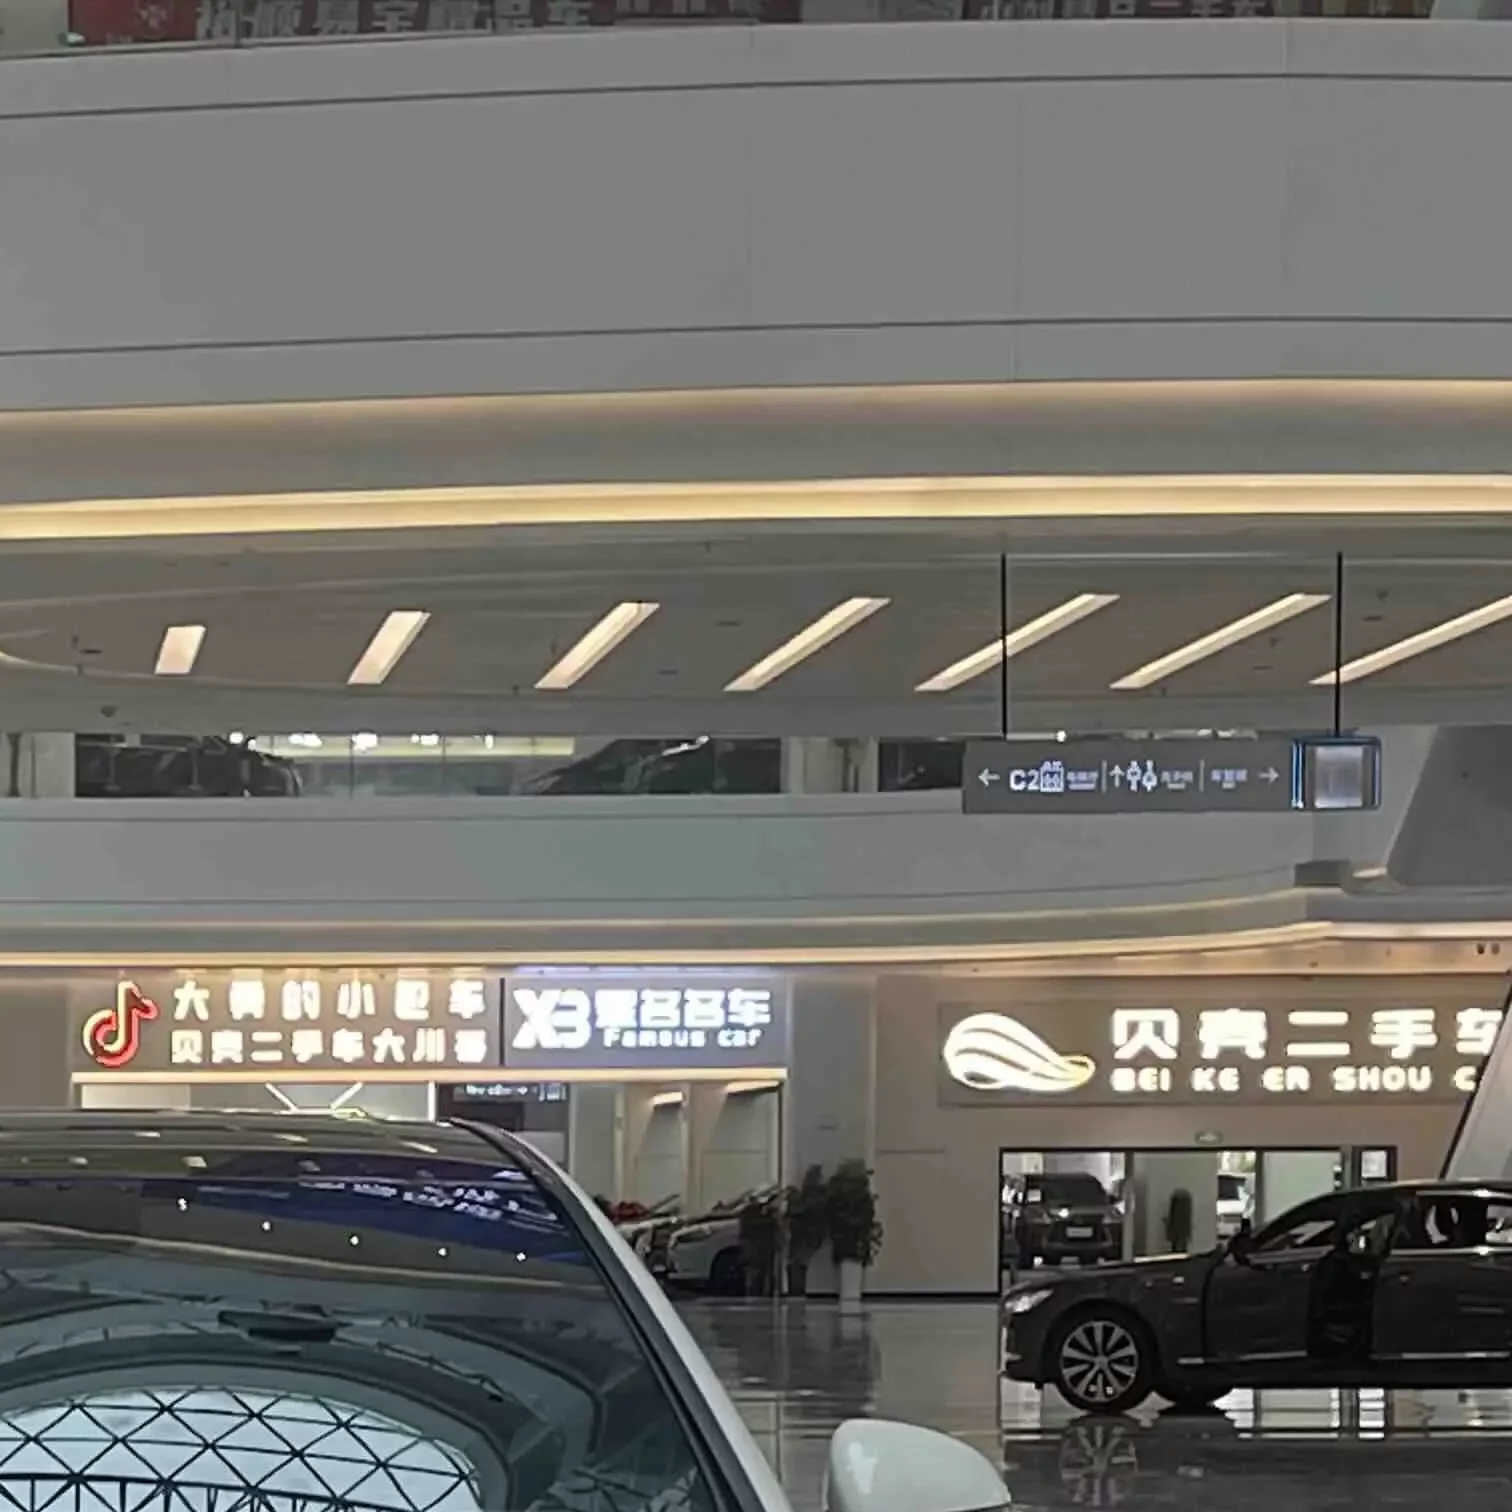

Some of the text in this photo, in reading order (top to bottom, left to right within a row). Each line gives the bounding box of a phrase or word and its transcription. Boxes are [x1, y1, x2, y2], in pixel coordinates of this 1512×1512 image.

[1111, 1008, 1504, 1060] 贝壳二手车
[1110, 1066, 1171, 1092] BEI
[1191, 1066, 1240, 1092] KE
[1260, 1066, 1311, 1092] ER
[1331, 1066, 1432, 1092] SHOU
